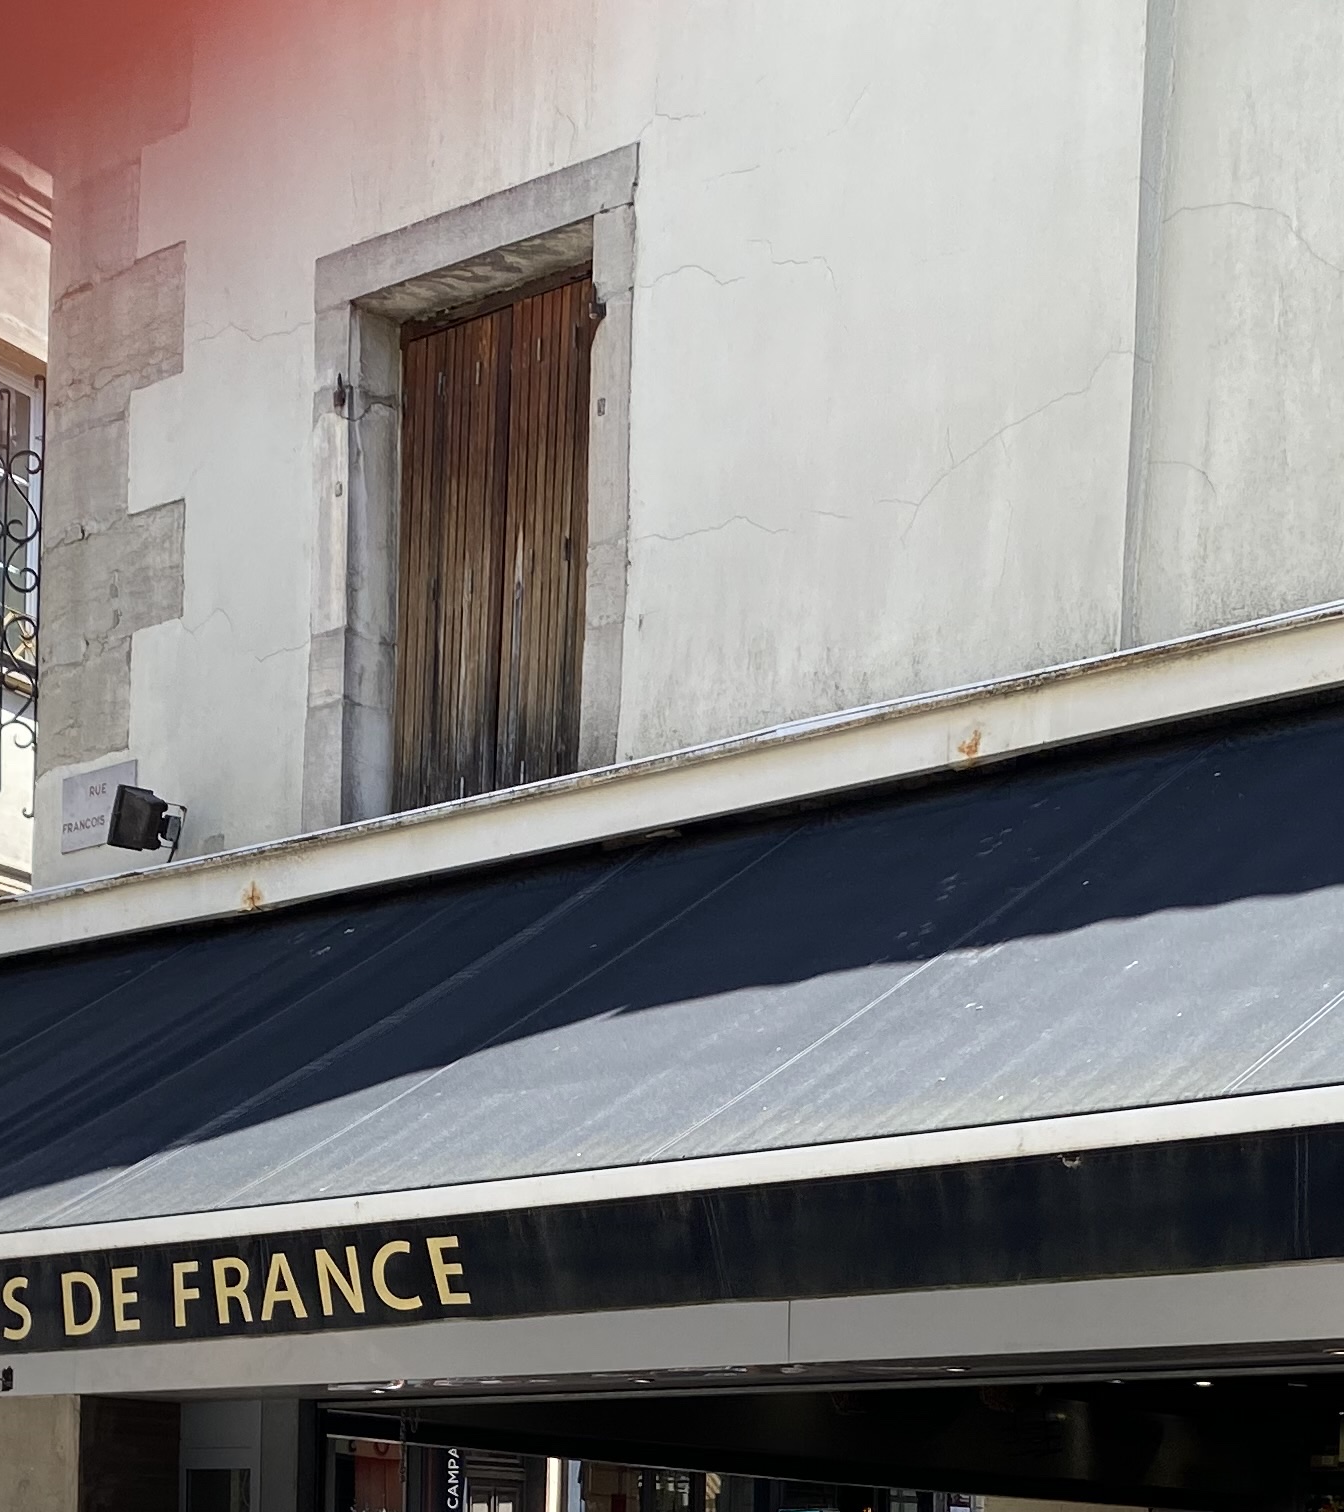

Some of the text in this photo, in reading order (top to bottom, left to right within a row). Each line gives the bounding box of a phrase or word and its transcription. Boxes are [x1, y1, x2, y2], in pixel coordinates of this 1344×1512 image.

[89, 782, 107, 797] RUE
[60, 1265, 141, 1336] DE
[172, 1235, 472, 1328] FRANCE
